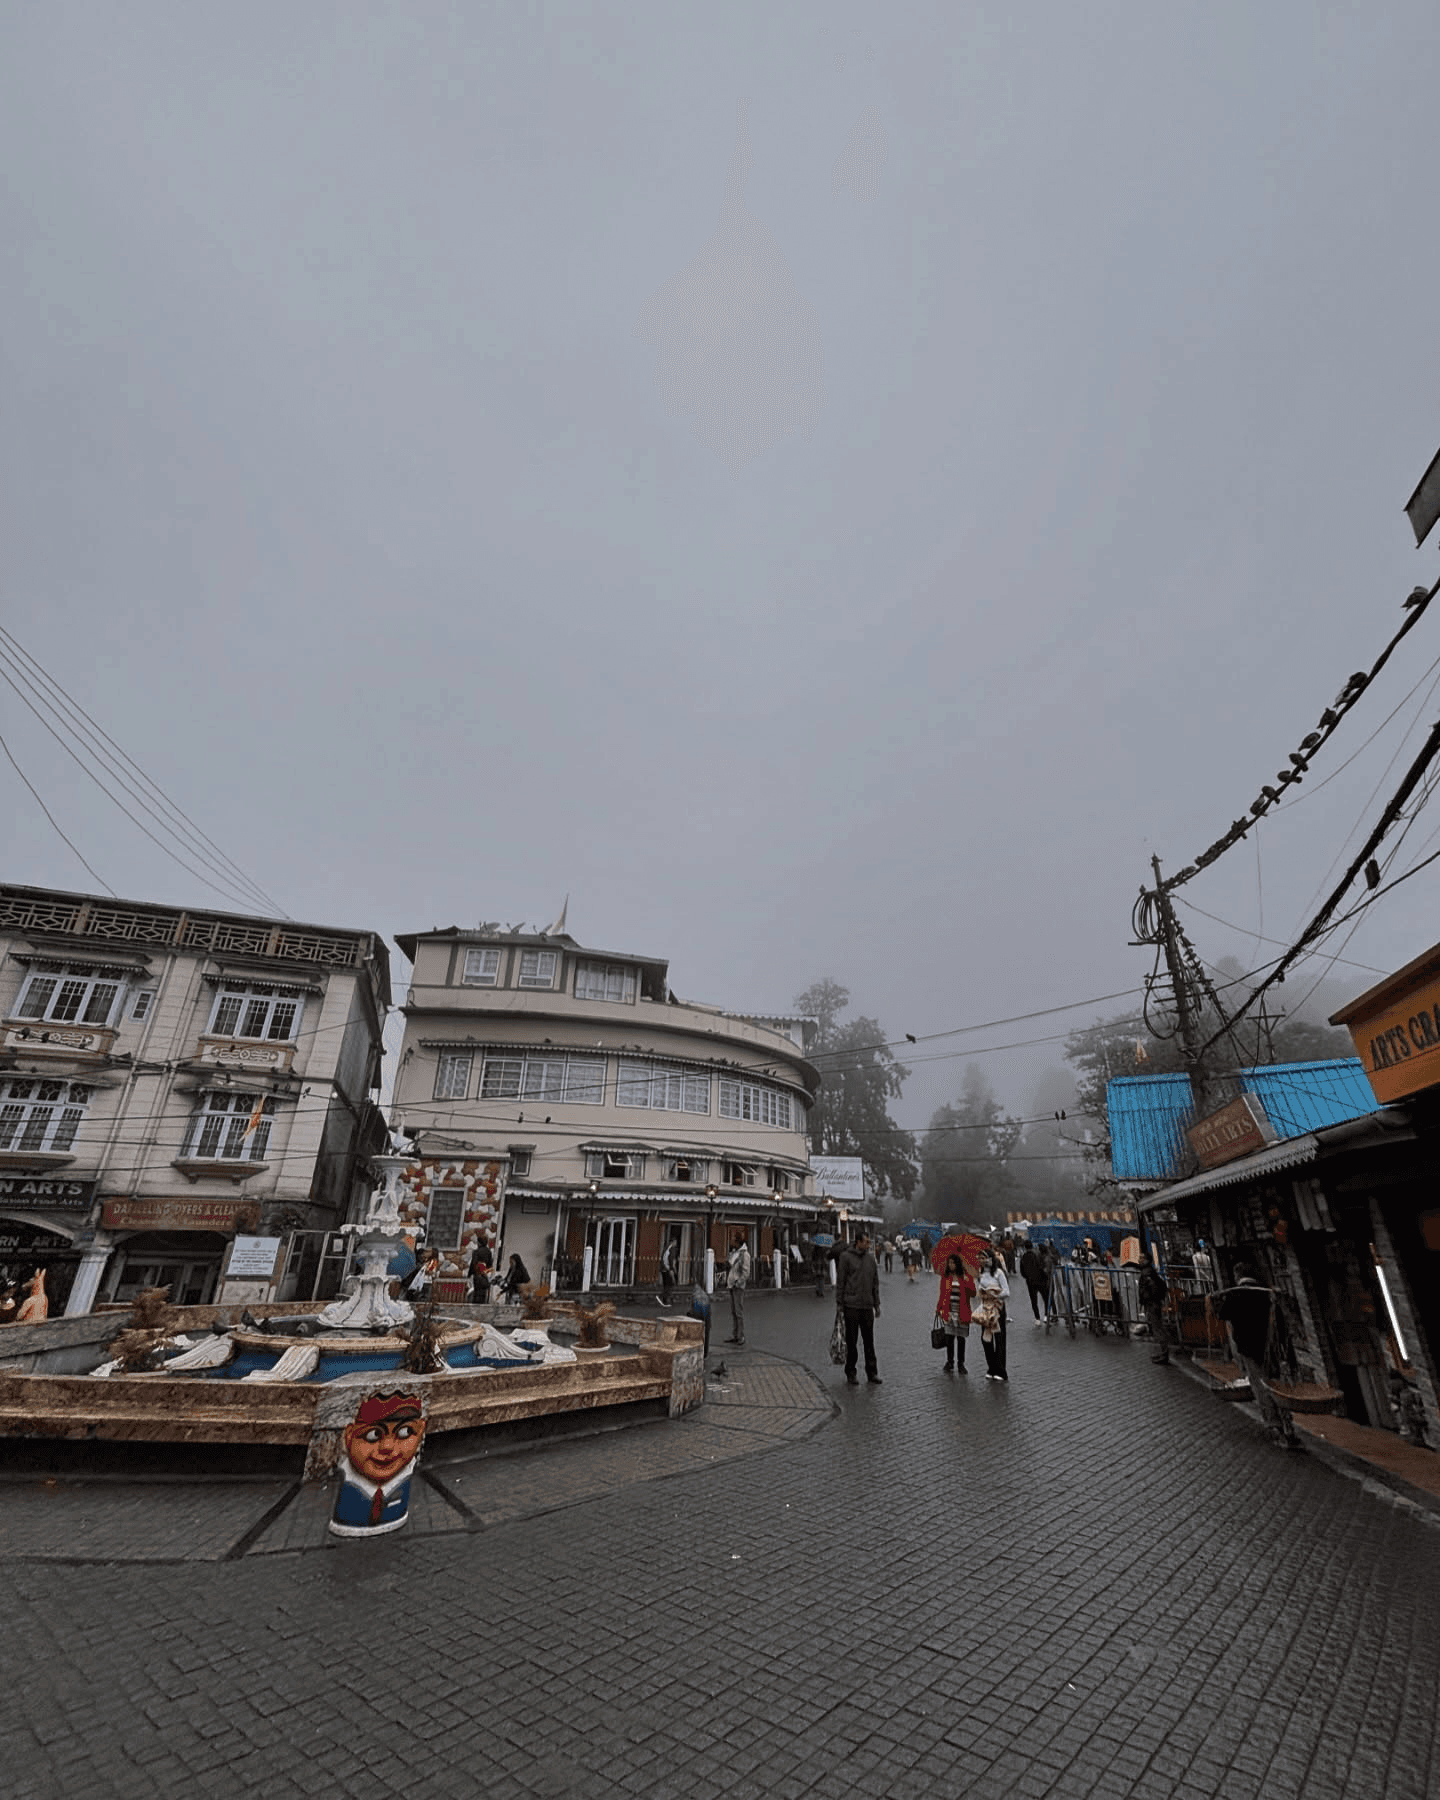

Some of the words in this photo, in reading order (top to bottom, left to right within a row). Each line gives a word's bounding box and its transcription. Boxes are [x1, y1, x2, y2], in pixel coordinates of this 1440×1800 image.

[1370, 1024, 1412, 1071] ARTS
[19, 1181, 83, 1195] ARTS
[174, 1204, 203, 1215] DYERS
